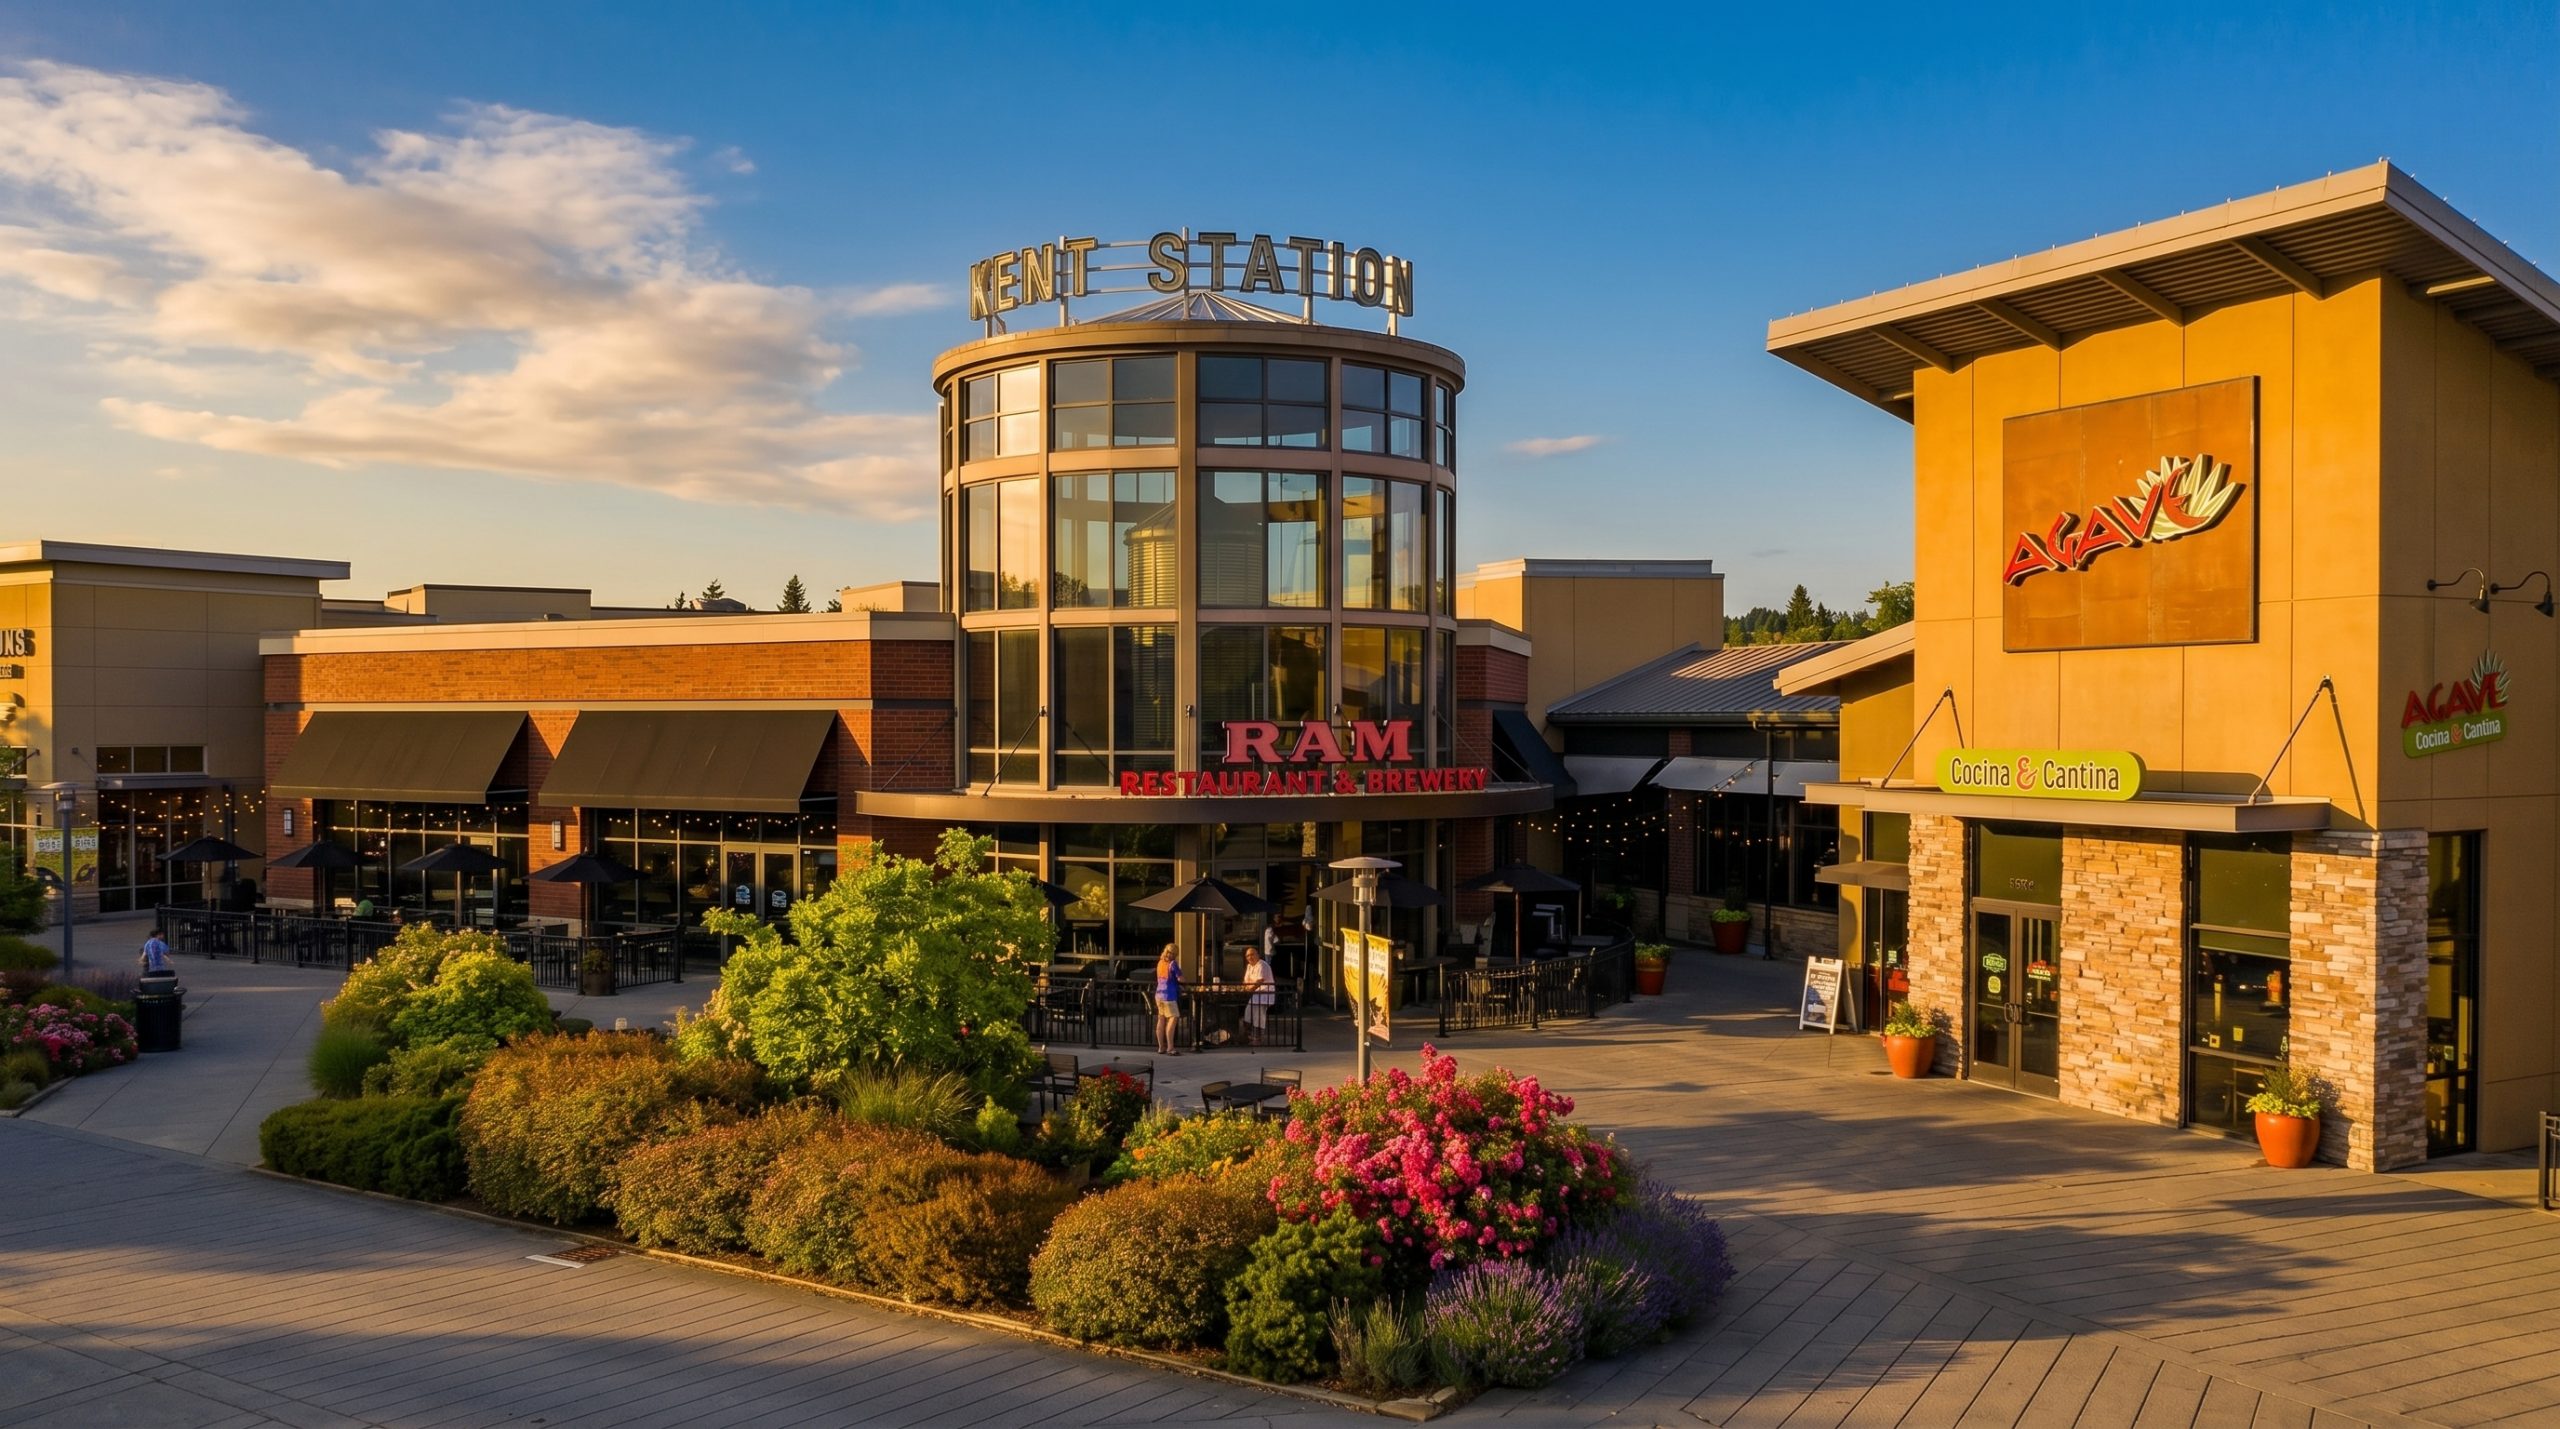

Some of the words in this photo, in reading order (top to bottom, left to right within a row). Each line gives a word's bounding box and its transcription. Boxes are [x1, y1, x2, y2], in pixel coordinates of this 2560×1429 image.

[970, 236, 1098, 321] KENT
[1147, 231, 1414, 317] STATION
[2002, 461, 2211, 586] AGAVE
[2401, 671, 2508, 729] AGAVE
[1222, 720, 1413, 764] RAM
[2415, 729, 2450, 750] Cocina
[2451, 723, 2463, 744] &
[2463, 718, 2501, 739] Cantina
[1120, 770, 1328, 796] RESTAURANT
[1333, 769, 1359, 794] &
[1366, 767, 1489, 793] BREWERY
[1951, 757, 2010, 786] Cocina
[2016, 756, 2038, 790] &
[2043, 760, 2120, 791] Cantina
